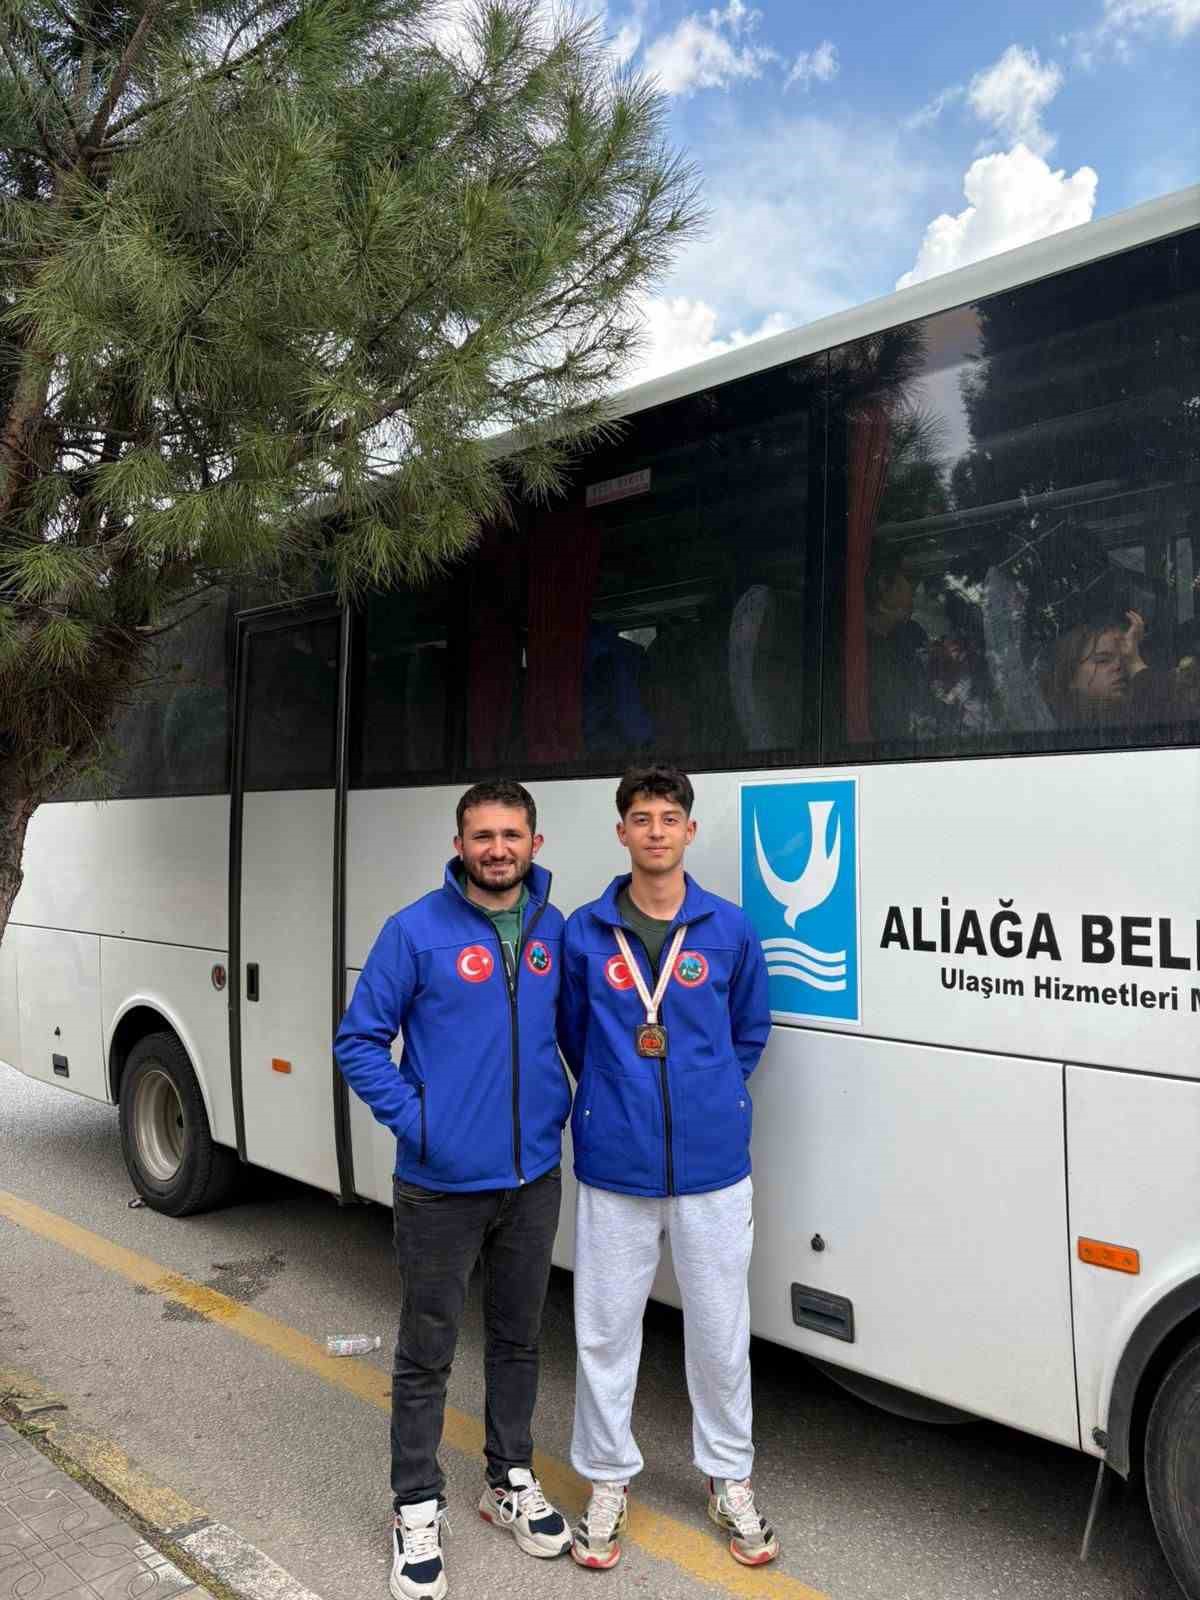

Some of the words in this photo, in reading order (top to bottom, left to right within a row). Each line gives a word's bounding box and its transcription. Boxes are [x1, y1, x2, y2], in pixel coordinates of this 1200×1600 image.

[880, 896, 1062, 961] ALİAĞA
[940, 967, 1024, 999] Ulaşım
[1034, 975, 1179, 1011] Hizmetleri
